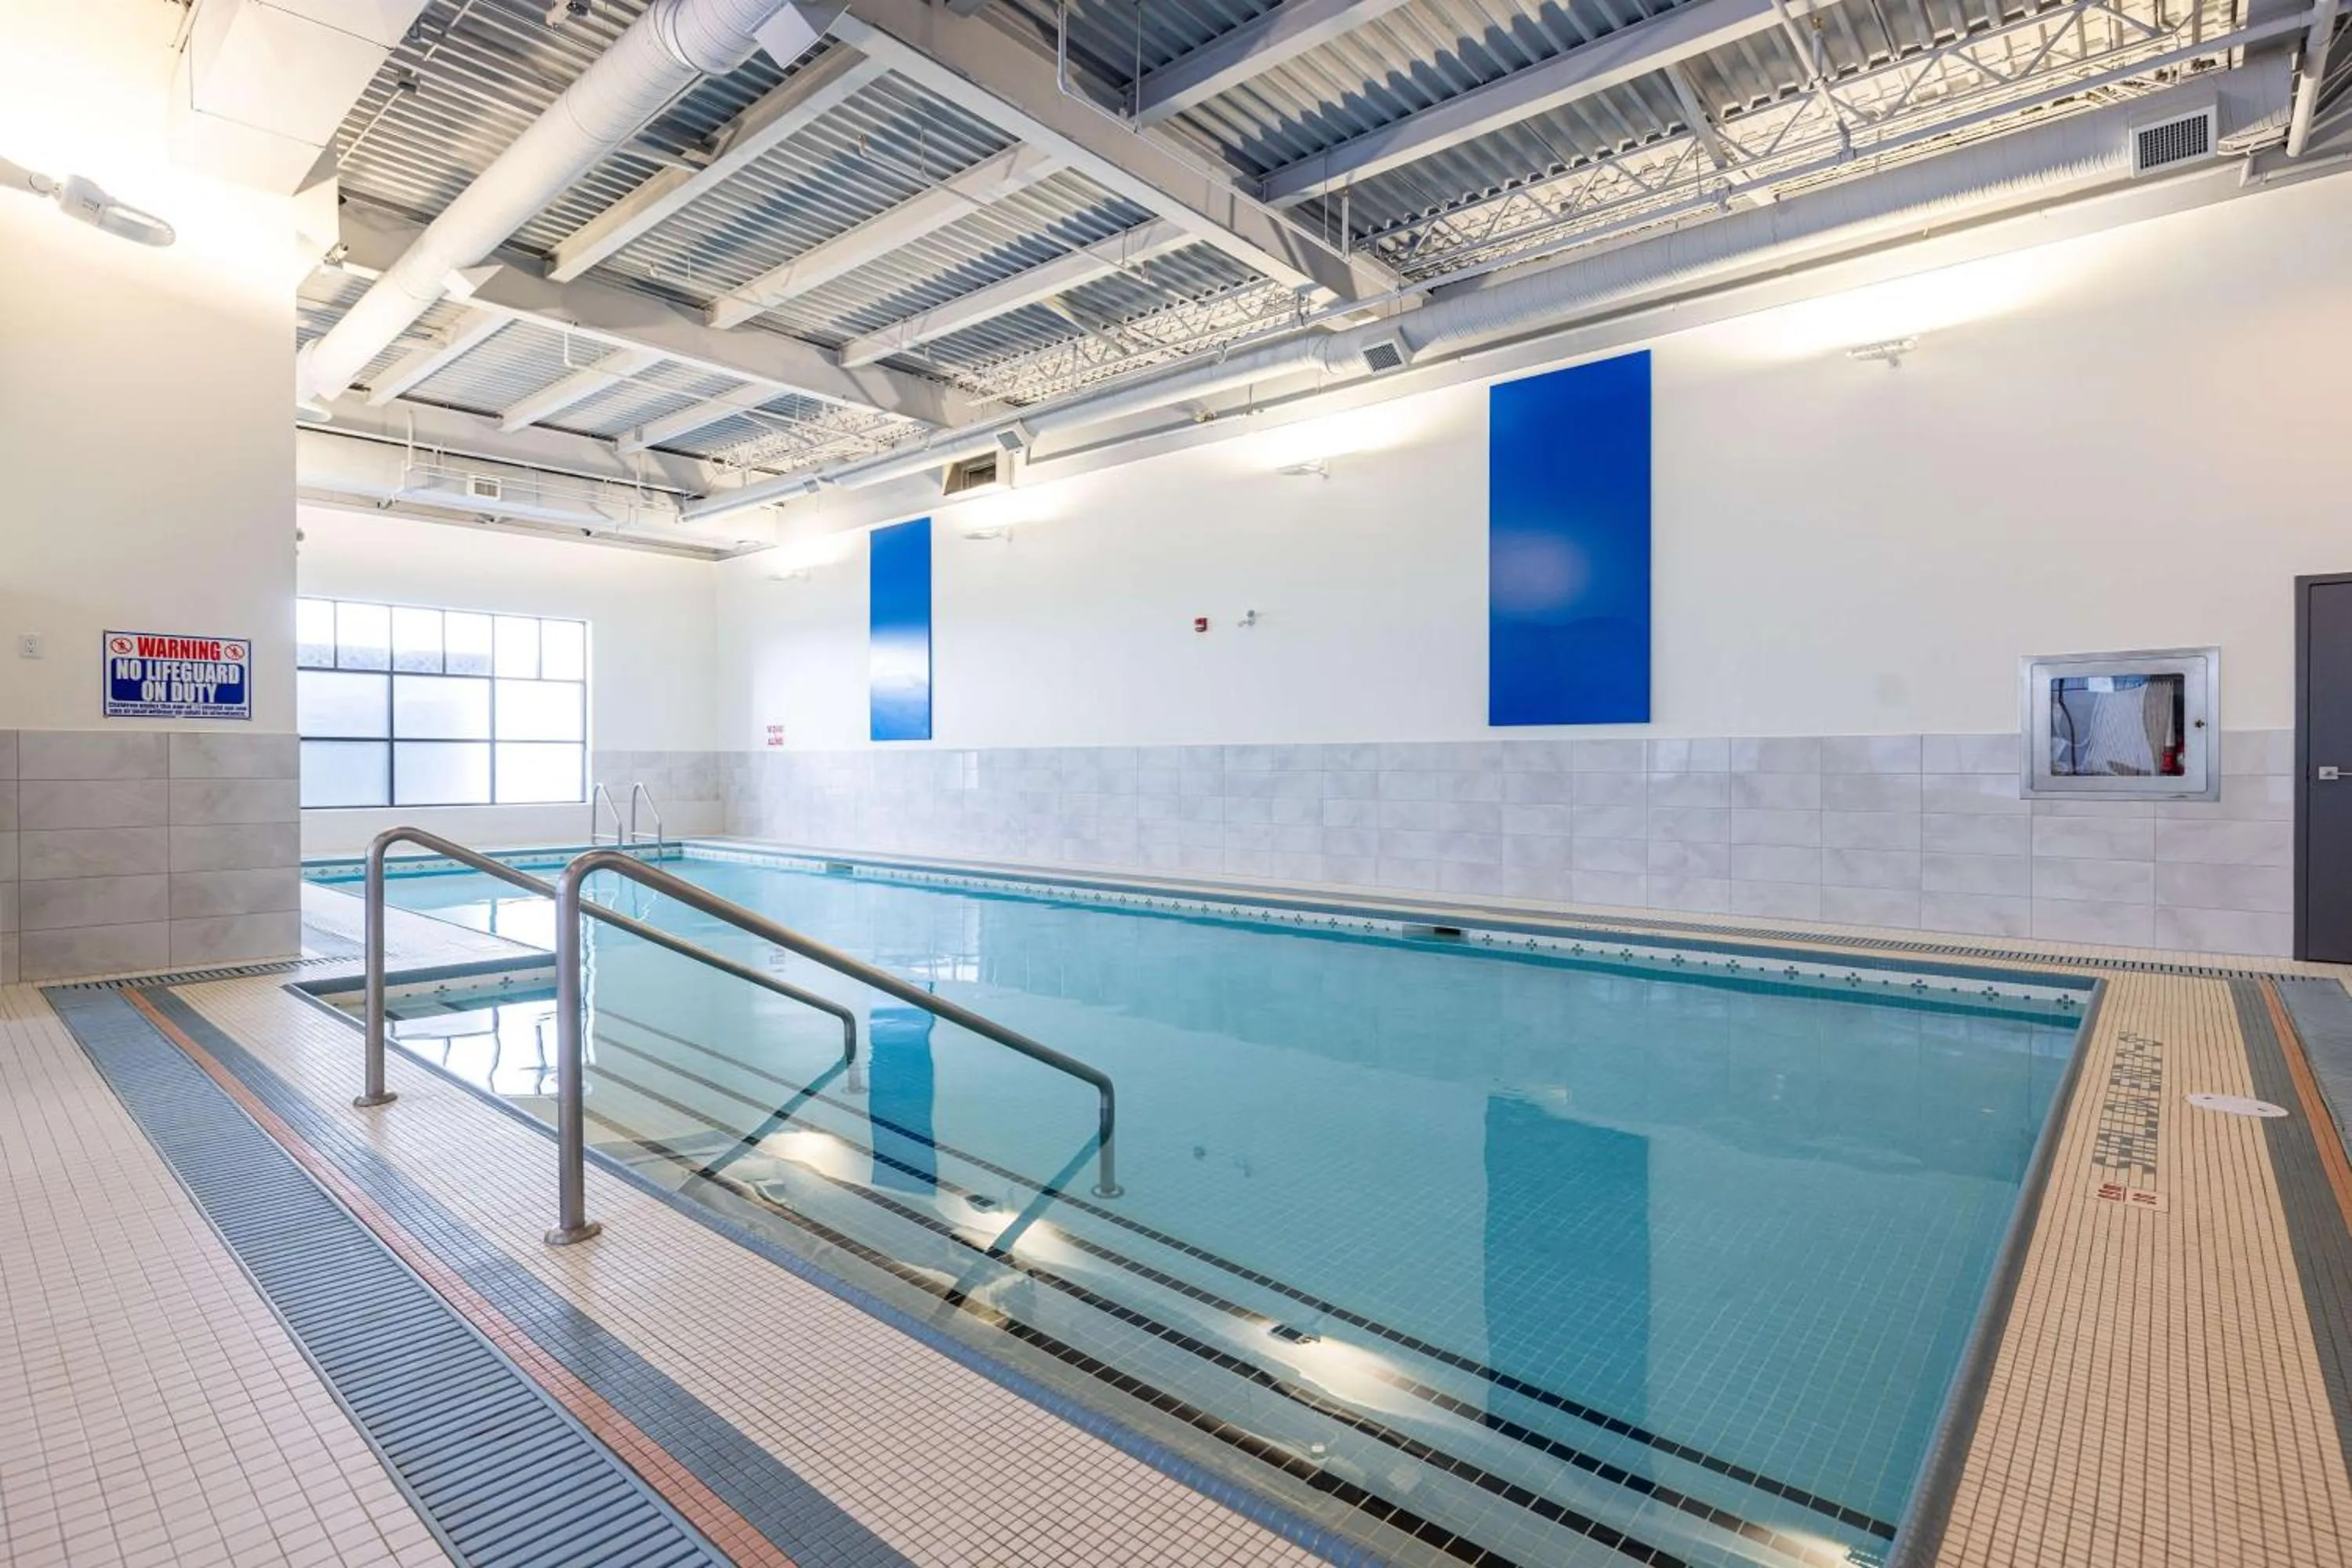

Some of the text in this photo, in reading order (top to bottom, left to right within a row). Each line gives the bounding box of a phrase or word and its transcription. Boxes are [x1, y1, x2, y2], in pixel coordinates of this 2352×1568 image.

[137, 637, 221, 660] WARNING
[116, 659, 240, 684] NO LIFEGUARD
[141, 681, 218, 703] ON DUTY
